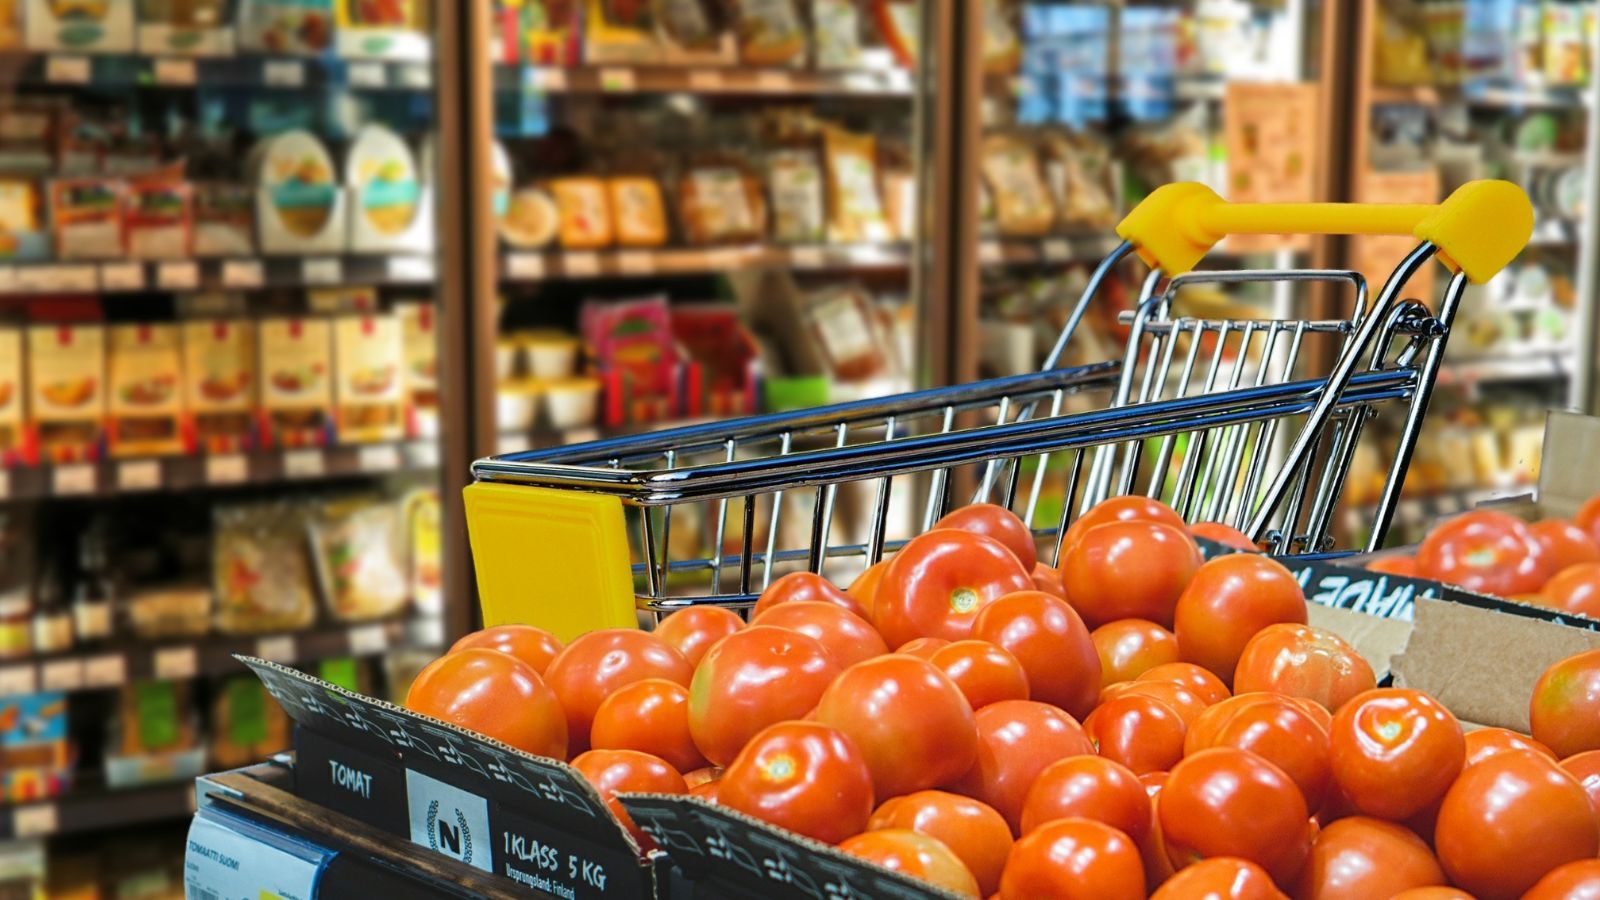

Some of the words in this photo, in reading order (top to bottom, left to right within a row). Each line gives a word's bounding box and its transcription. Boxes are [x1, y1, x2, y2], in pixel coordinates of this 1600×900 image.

[328, 759, 373, 800] TOMAT
[438, 818, 461, 856] N
[188, 840, 219, 863] TOMAATTI
[219, 854, 240, 873] SUOMI
[511, 833, 559, 872] KLASS
[568, 854, 578, 879] 5
[582, 859, 607, 892] KG
[505, 862, 553, 893] Ursprungsland:
[552, 880, 575, 900] Finland
